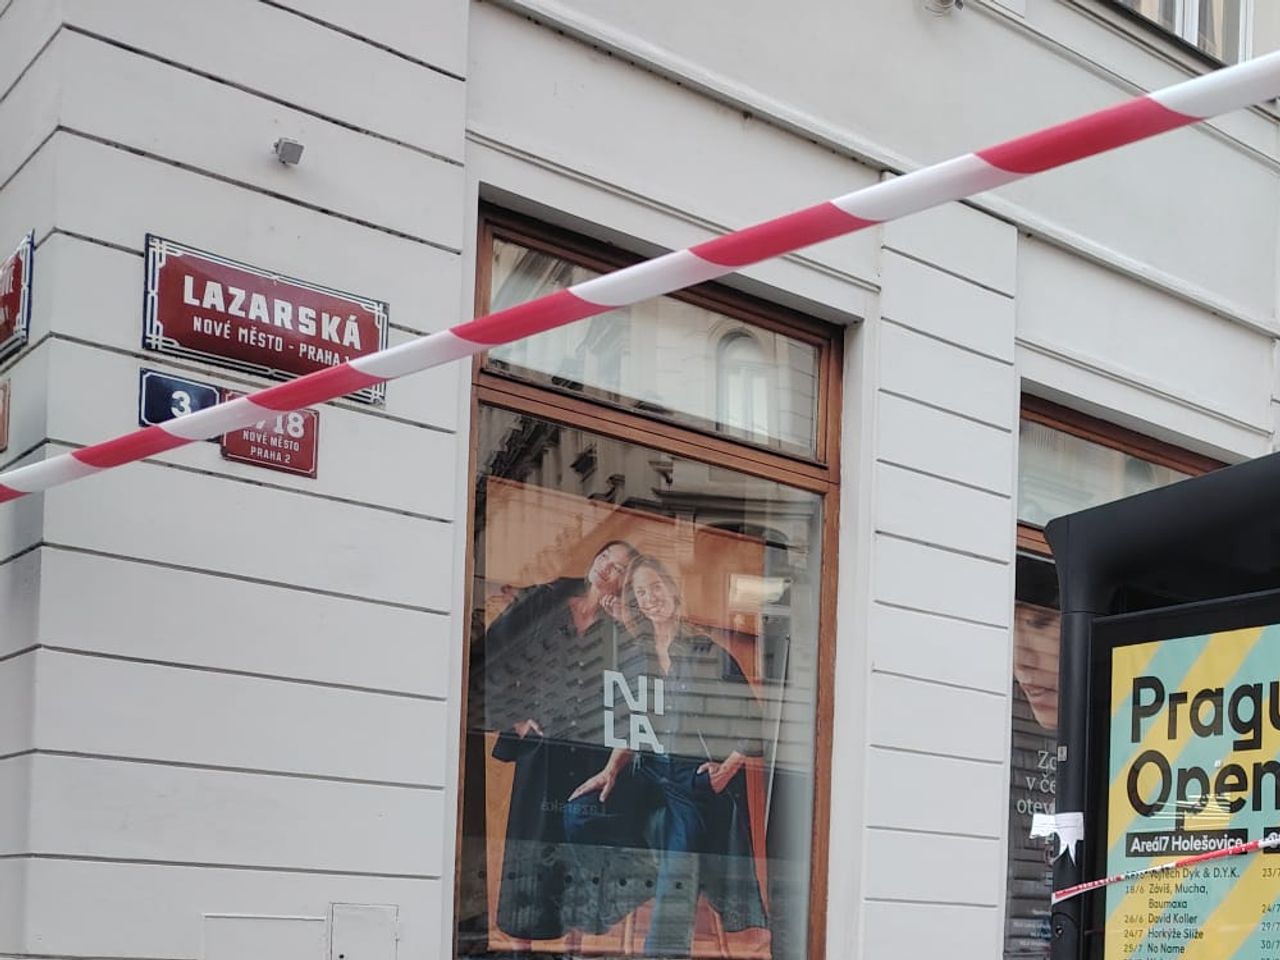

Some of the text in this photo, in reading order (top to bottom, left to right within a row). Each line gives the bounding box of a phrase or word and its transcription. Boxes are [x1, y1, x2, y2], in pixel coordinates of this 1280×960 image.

[184, 275, 361, 350] LAZARSKÁ
[193, 316, 231, 338] NOVÉ
[238, 327, 283, 351] MĚSTO
[299, 343, 341, 366] PRAHA
[171, 391, 192, 418] 3
[254, 411, 305, 438] 18
[243, 430, 300, 451] NOVÉ MĚSTO
[250, 446, 291, 463] PRAHA 2
[604, 669, 664, 715] NI
[604, 710, 664, 754] LA
[1130, 834, 1243, 853] Areál7 Holešovice
[1182, 867, 1200, 880] Dyk
[1203, 868, 1211, 878] &
[1213, 867, 1240, 878] D.Y.K.
[1175, 884, 1209, 895] Mucha,
[1262, 904, 1280, 913] 24/7
[1148, 913, 1171, 923] David
[1173, 913, 1198, 924] Koller
[1261, 922, 1280, 932] 29/7
[1147, 944, 1158, 954] No
[1160, 944, 1185, 954] Name
[1260, 940, 1280, 950] 30/7
